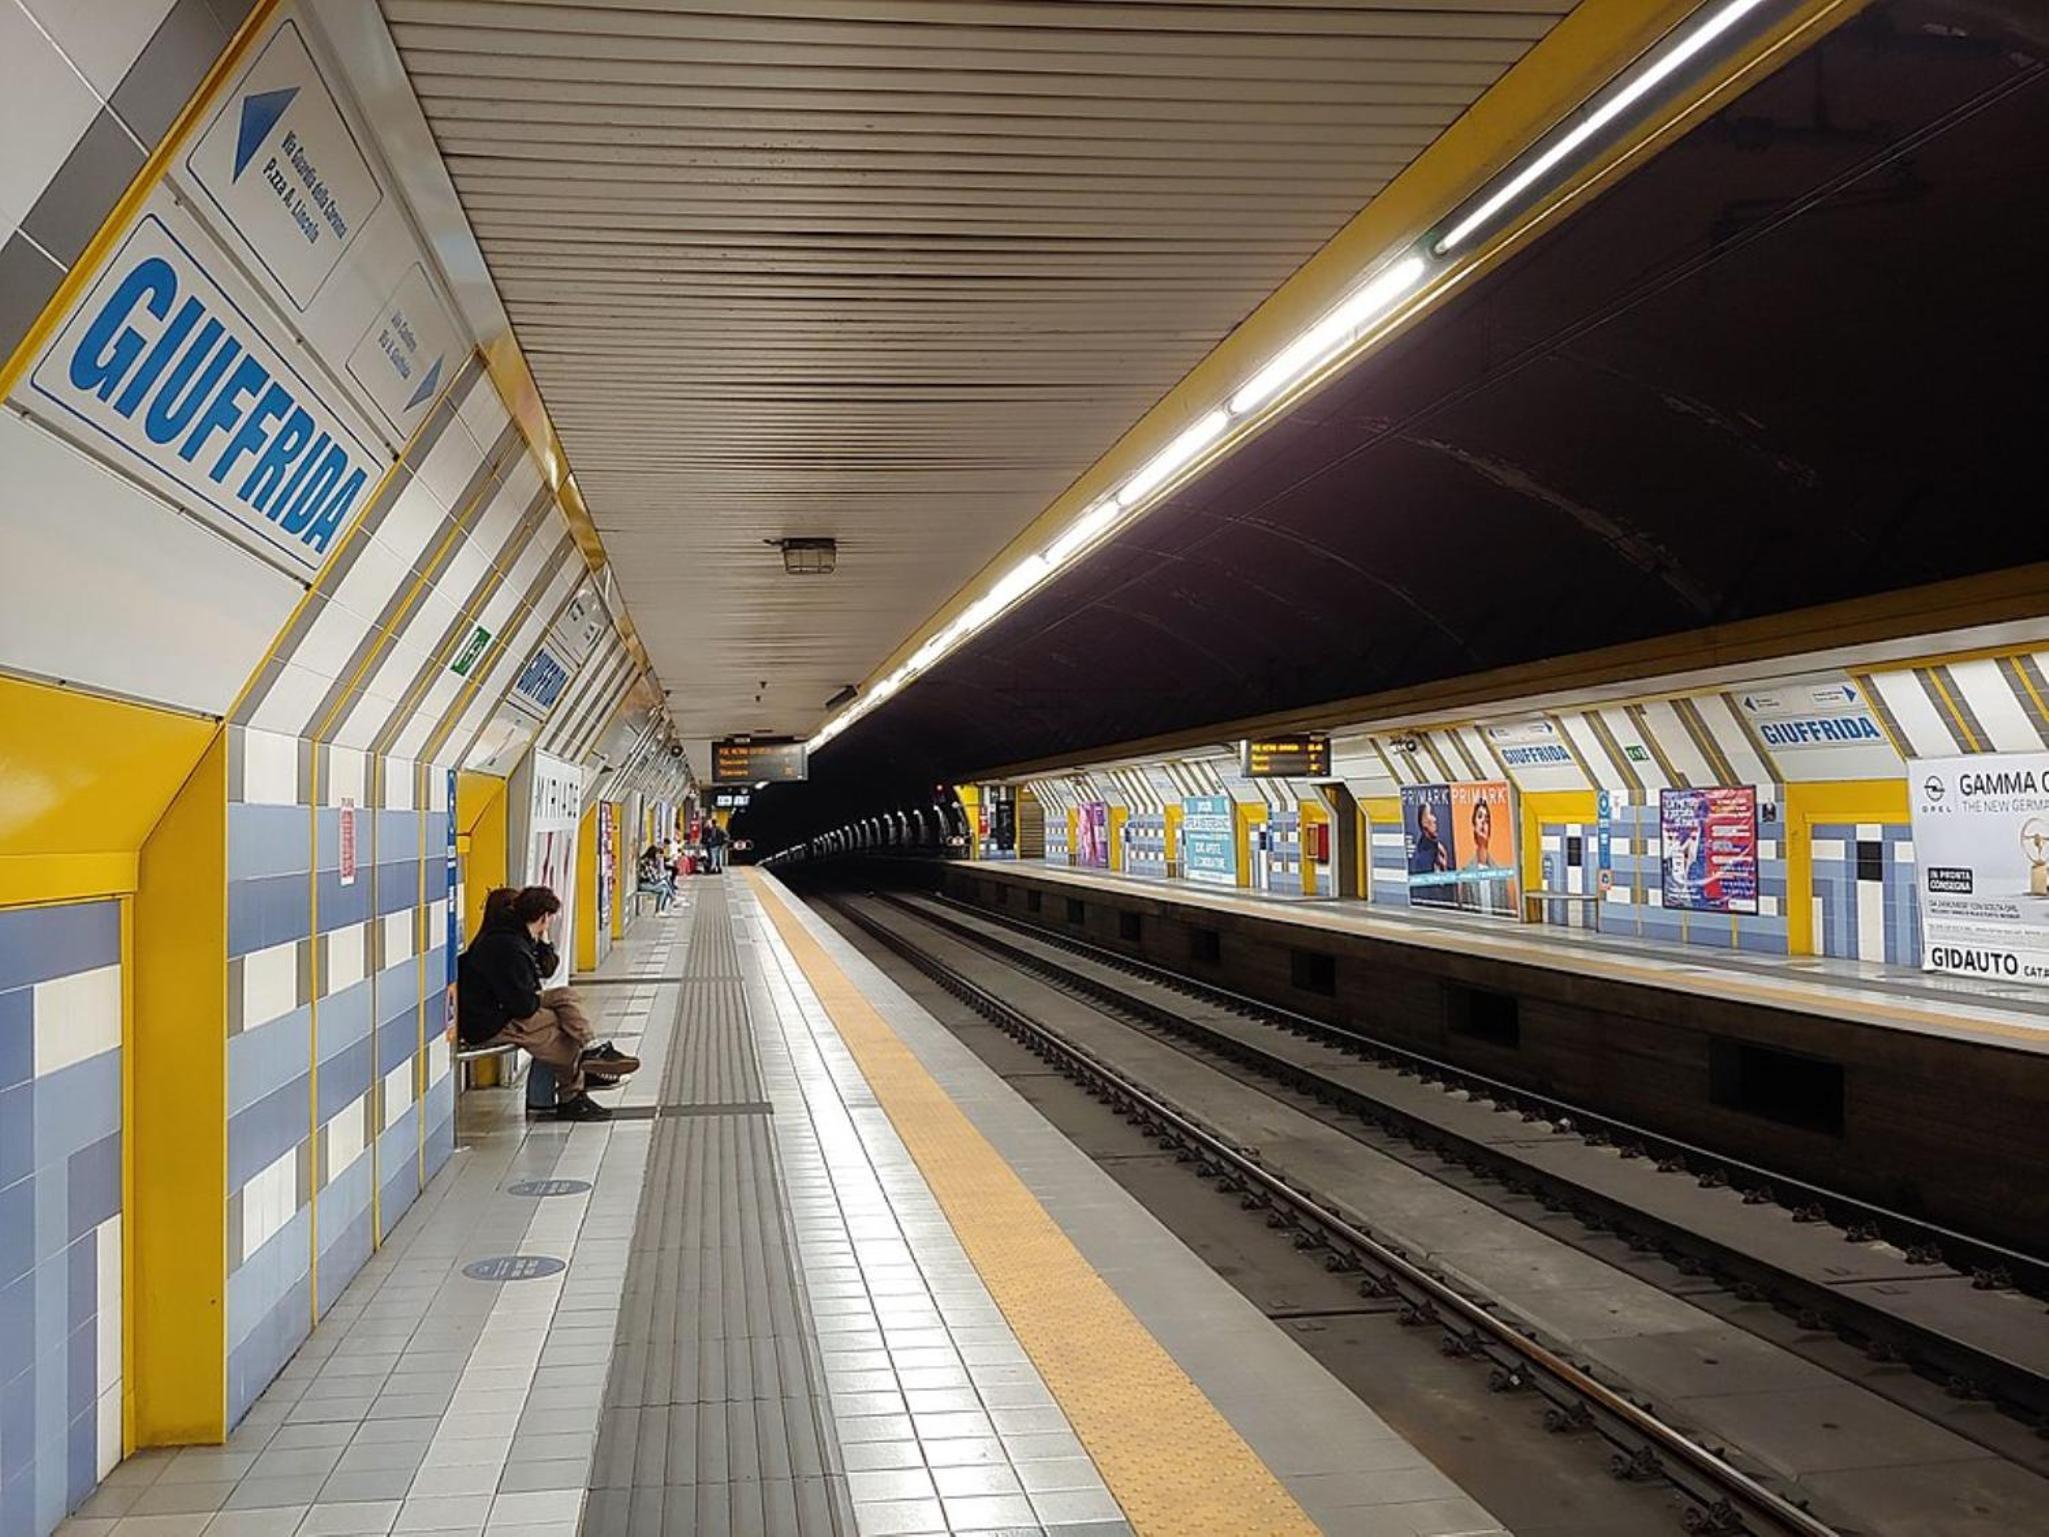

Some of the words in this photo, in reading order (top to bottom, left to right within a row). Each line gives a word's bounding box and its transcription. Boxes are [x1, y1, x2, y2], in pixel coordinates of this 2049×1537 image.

[281, 130, 296, 157] Via
[291, 147, 316, 189] Guardia
[311, 181, 328, 210] della
[263, 157, 287, 196] P.zza
[291, 199, 319, 244] Lincoln
[69, 257, 368, 554] GIUFFRIDA
[1761, 717, 1880, 744] GIUFFRIDA
[1502, 745, 1571, 764] GIUFFRIDA
[1960, 771, 2037, 796] GAMMA
[1402, 788, 1449, 805] PRIMARK
[1453, 786, 1507, 804] PRIMARK
[1921, 805, 1951, 814] OPEL
[1962, 801, 1982, 813] THE
[1984, 801, 2009, 813] NEW
[1940, 870, 1971, 880] PRONTA
[1932, 947, 2019, 975] GIDAUTO
